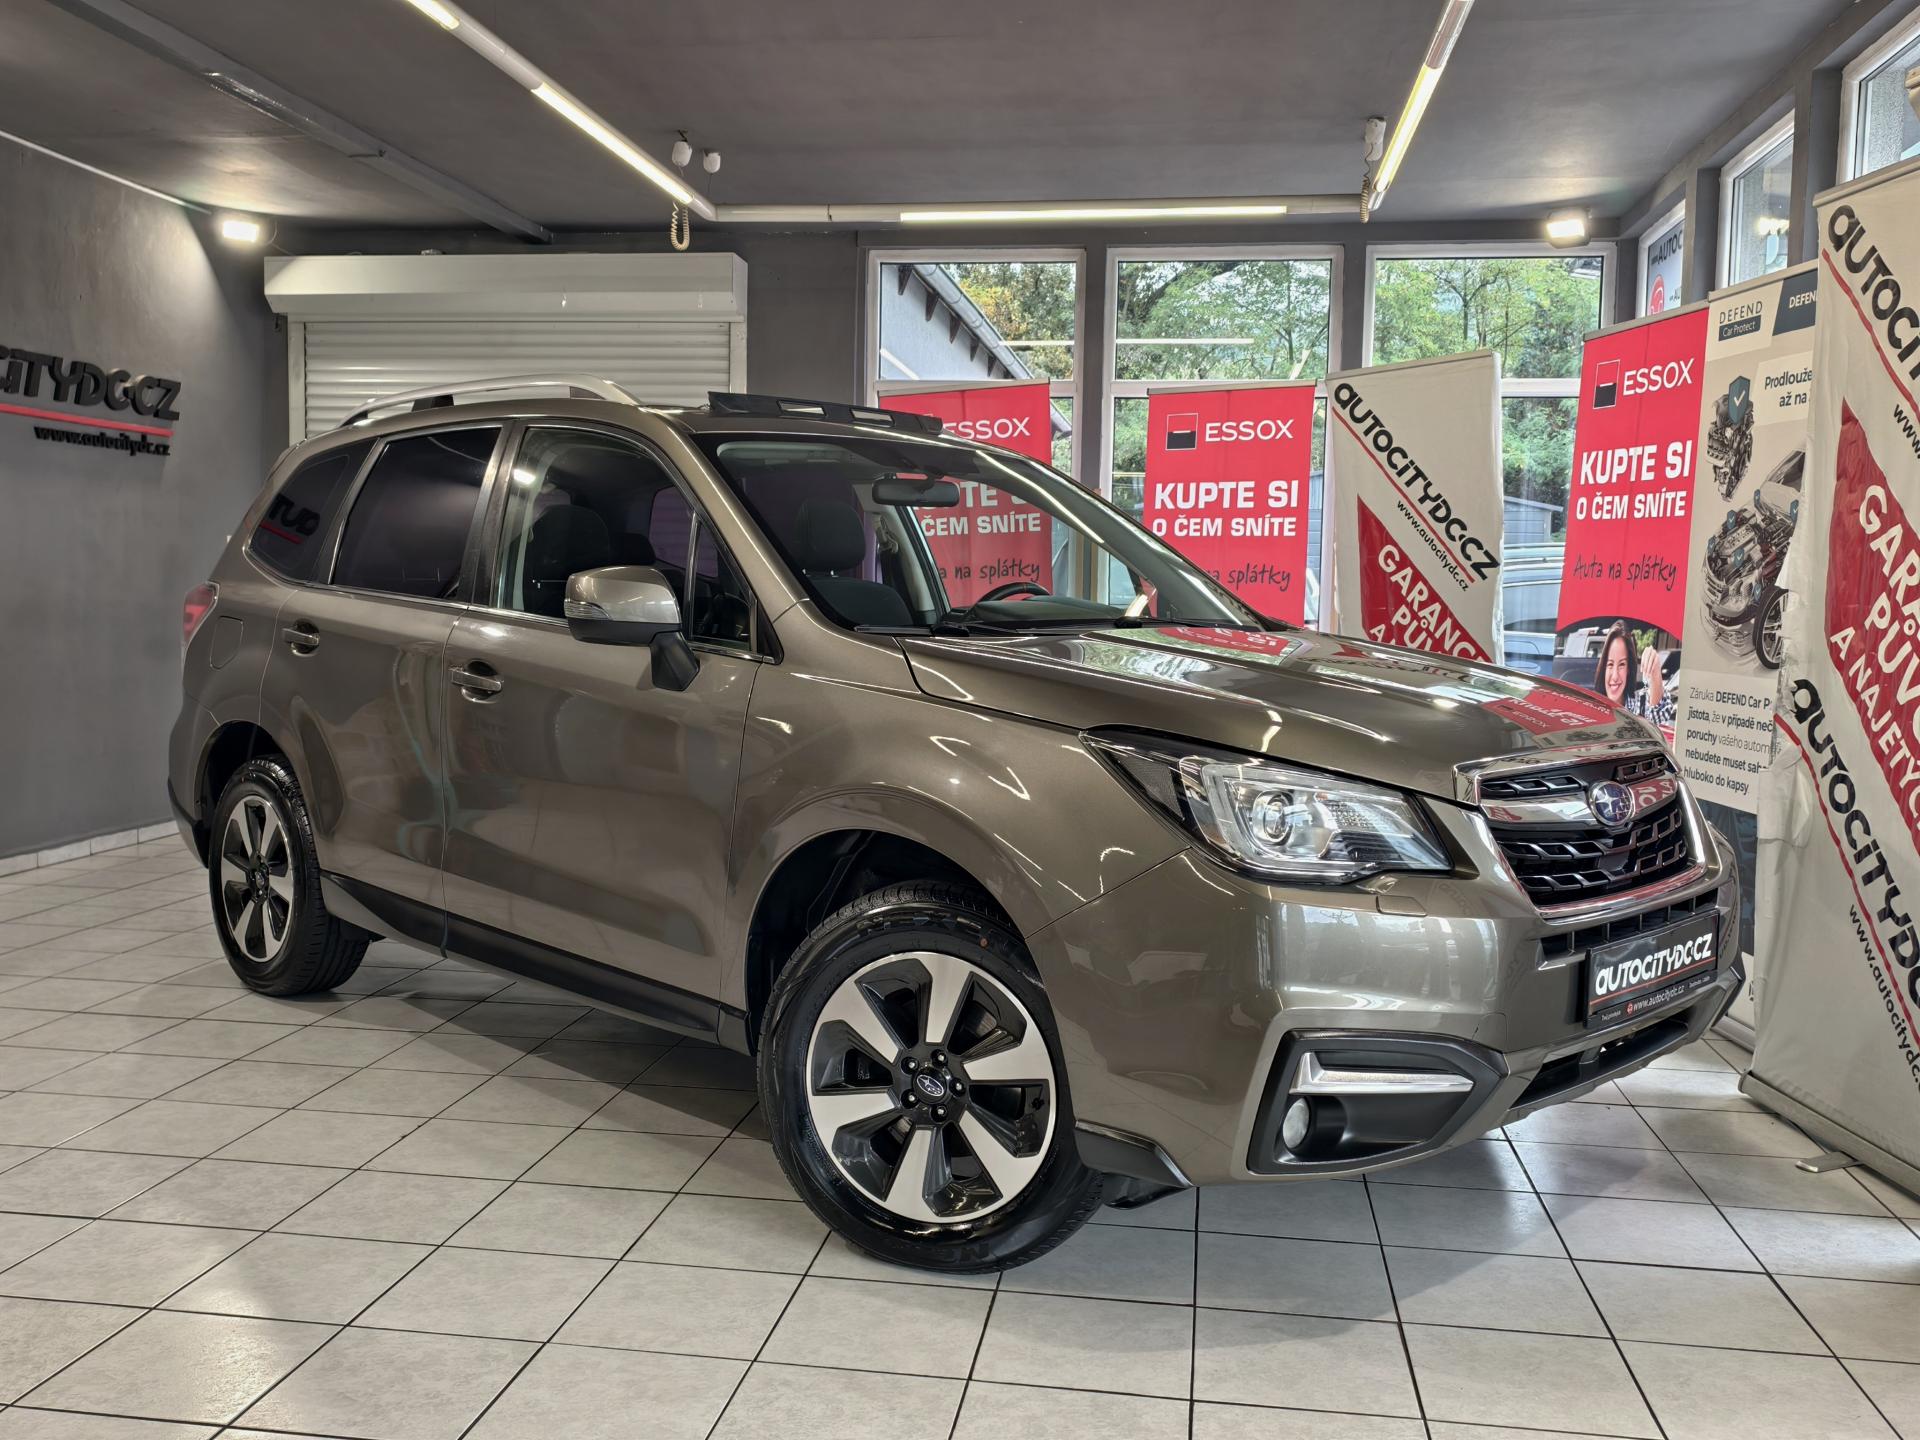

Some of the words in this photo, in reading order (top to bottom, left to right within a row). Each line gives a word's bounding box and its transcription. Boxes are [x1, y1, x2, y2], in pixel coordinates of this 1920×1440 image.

[1720, 301, 1763, 324] DEFEND
[1623, 358, 1695, 396] ESSOX
[1779, 392, 1791, 407] až
[1794, 393, 1807, 406] na
[1205, 419, 1295, 442] ESSOX
[1580, 444, 1657, 485] KUPTE
[1665, 440, 1693, 479] SI
[1154, 480, 1256, 509] KUPTE
[1267, 480, 1299, 508] SI
[1576, 497, 1587, 520] O
[1591, 493, 1628, 520] ČEM
[1633, 487, 1687, 519] SNÍTE
[921, 514, 969, 536] ČEM
[976, 511, 1041, 533] SNÍTE
[1152, 518, 1168, 537] O
[1174, 514, 1223, 537] ČEM
[1230, 514, 1297, 537] SNÍTE
[1397, 500, 1469, 592] www.autocitydc.cz
[954, 566, 971, 579] na
[979, 558, 1040, 584] splátky
[1227, 563, 1290, 592] splátky
[1573, 554, 1602, 579] Auta
[1608, 562, 1622, 580] na
[1627, 553, 1677, 591] splátky
[1378, 544, 1488, 662] GARANC
[1830, 627, 1855, 660] A
[1690, 687, 1714, 702] Záruka
[1715, 691, 1747, 706] DEFEND
[1748, 696, 1761, 708] Car
[1763, 698, 1773, 709] P
[1712, 710, 1720, 723] že
[1722, 715, 1727, 724] v
[1727, 714, 1755, 729] případě
[1686, 729, 1717, 746] poruchy
[1719, 734, 1743, 748] vašeho
[1685, 748, 1721, 765] nebudete
[1723, 756, 1746, 771] muset
[1683, 766, 1714, 784] hluboko
[1715, 774, 1725, 785] do
[1726, 777, 1749, 795] kapsy
